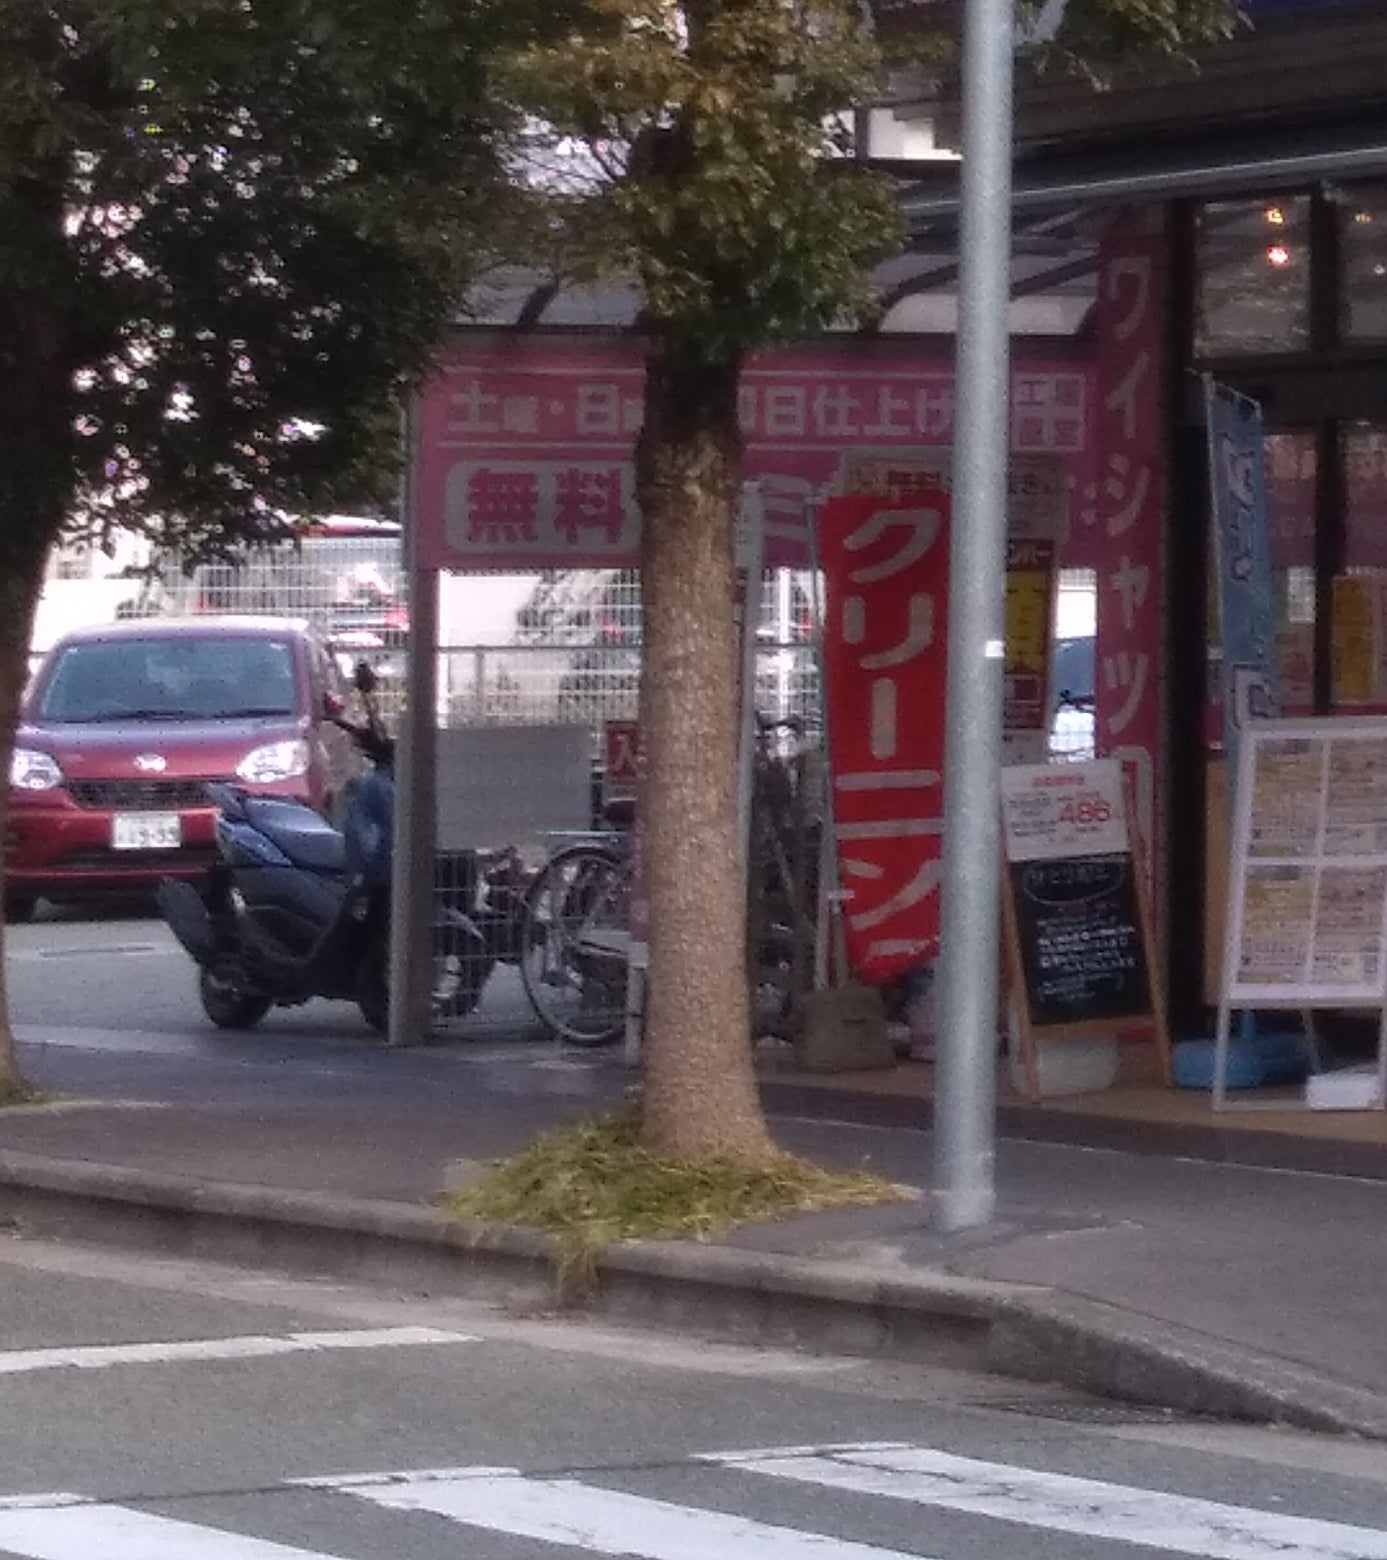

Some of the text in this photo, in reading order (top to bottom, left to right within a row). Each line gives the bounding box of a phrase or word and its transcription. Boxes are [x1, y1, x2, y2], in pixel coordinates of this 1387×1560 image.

[467, 466, 628, 544] 無料
[838, 508, 945, 958] クリーニン
